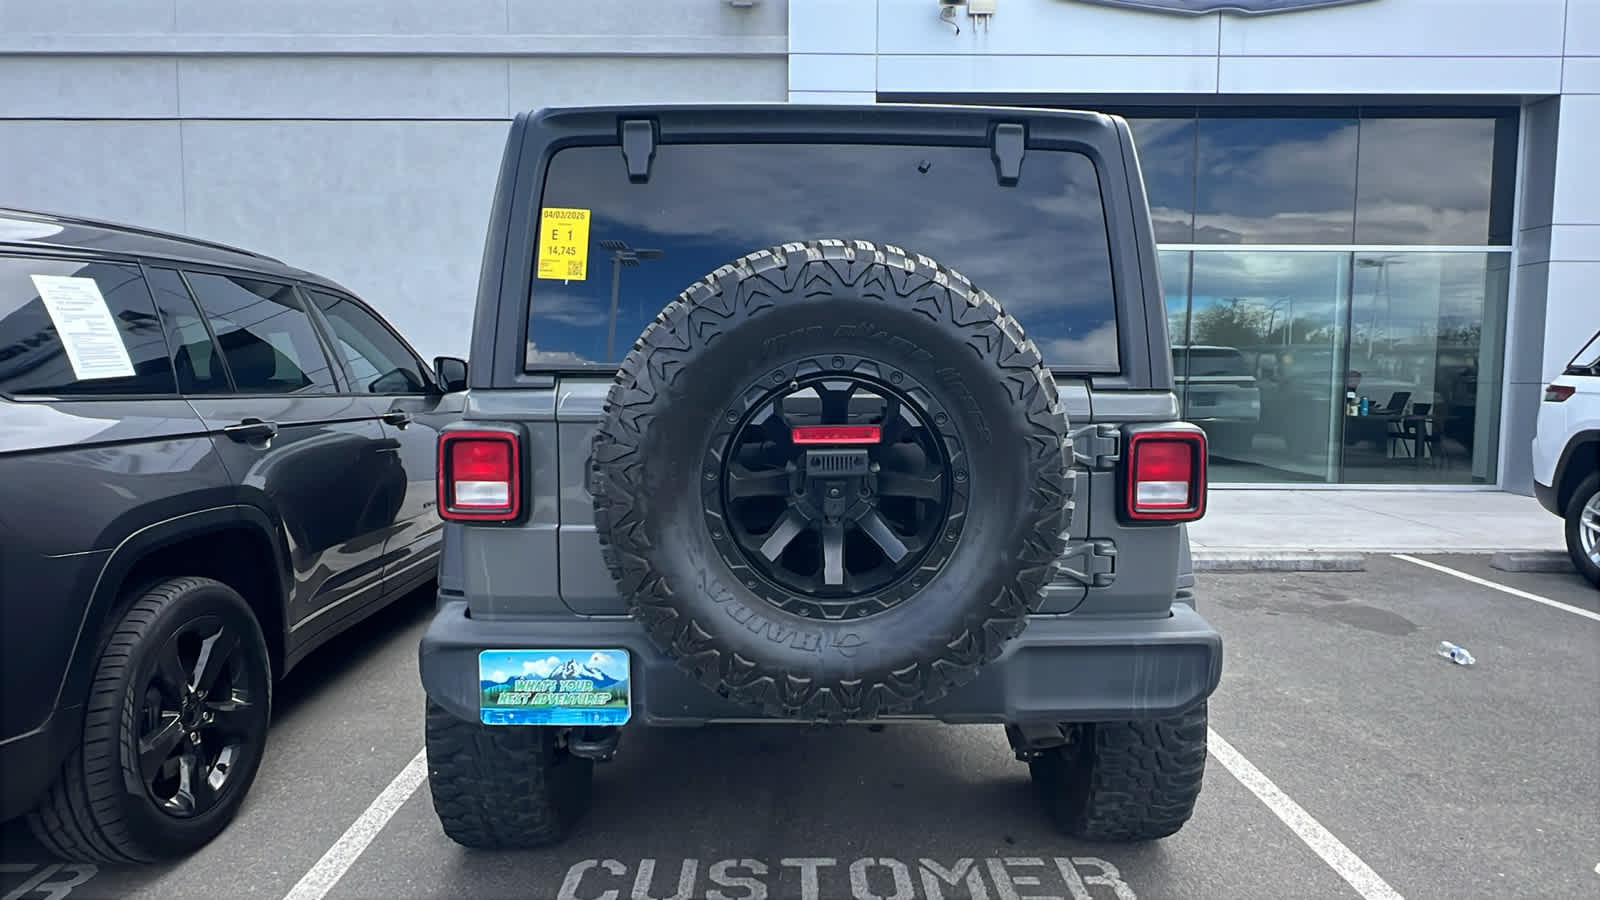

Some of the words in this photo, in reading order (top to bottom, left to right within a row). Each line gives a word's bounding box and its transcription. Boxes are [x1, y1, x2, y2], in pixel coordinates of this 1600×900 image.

[552, 229, 558, 240] E
[568, 230, 573, 240] 1
[548, 246, 576, 256] 14,745
[559, 680, 593, 692] YOUR
[497, 692, 531, 705] NEXT
[530, 692, 612, 705] ADVENTURE?
[556, 857, 1138, 900] CUSTOMER
